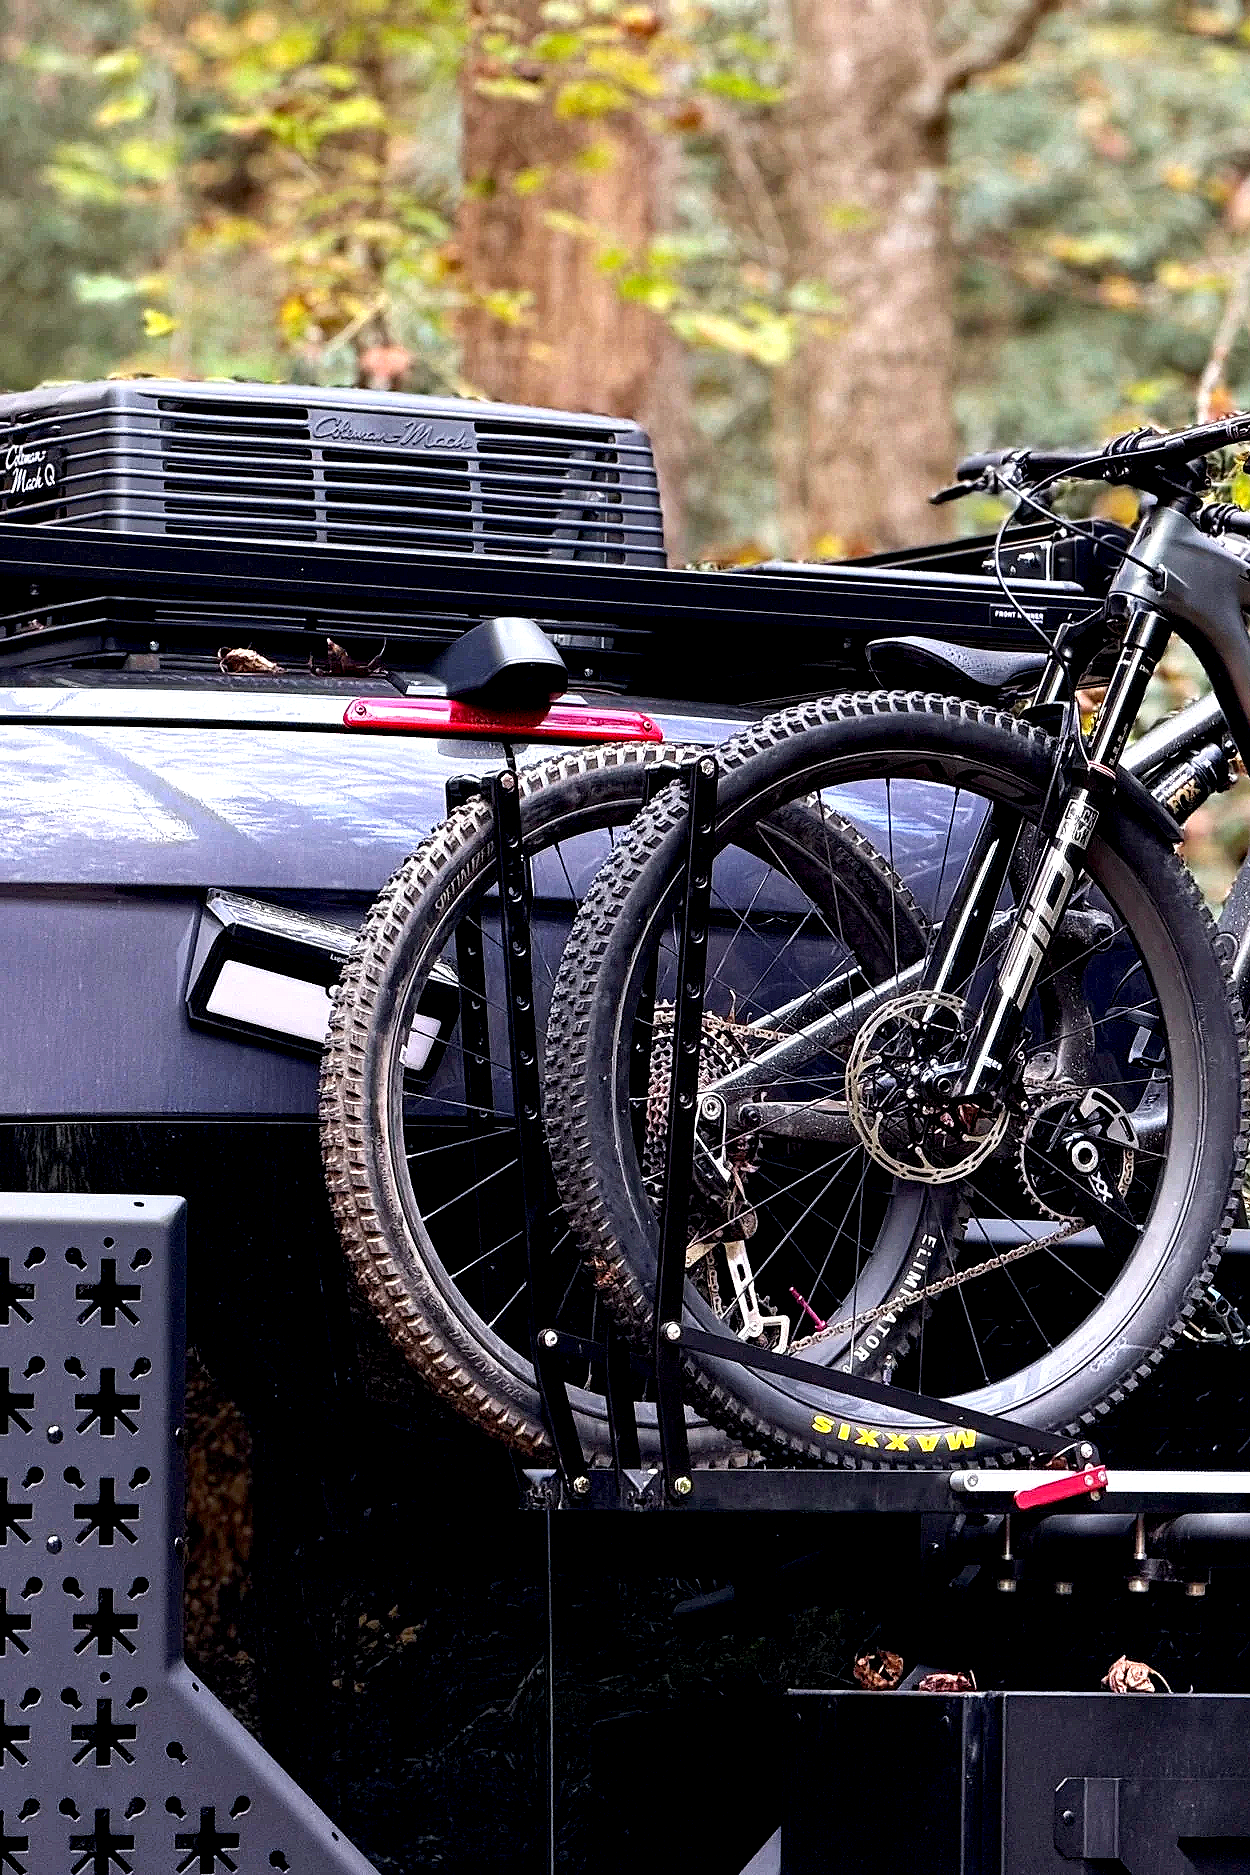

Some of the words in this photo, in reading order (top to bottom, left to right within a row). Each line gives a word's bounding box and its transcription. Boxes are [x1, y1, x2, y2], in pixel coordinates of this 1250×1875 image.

[994, 610, 1017, 618] FRONT
[853, 1233, 937, 1362] ELIMIATOR
[811, 1414, 977, 1452] MAXXIS
